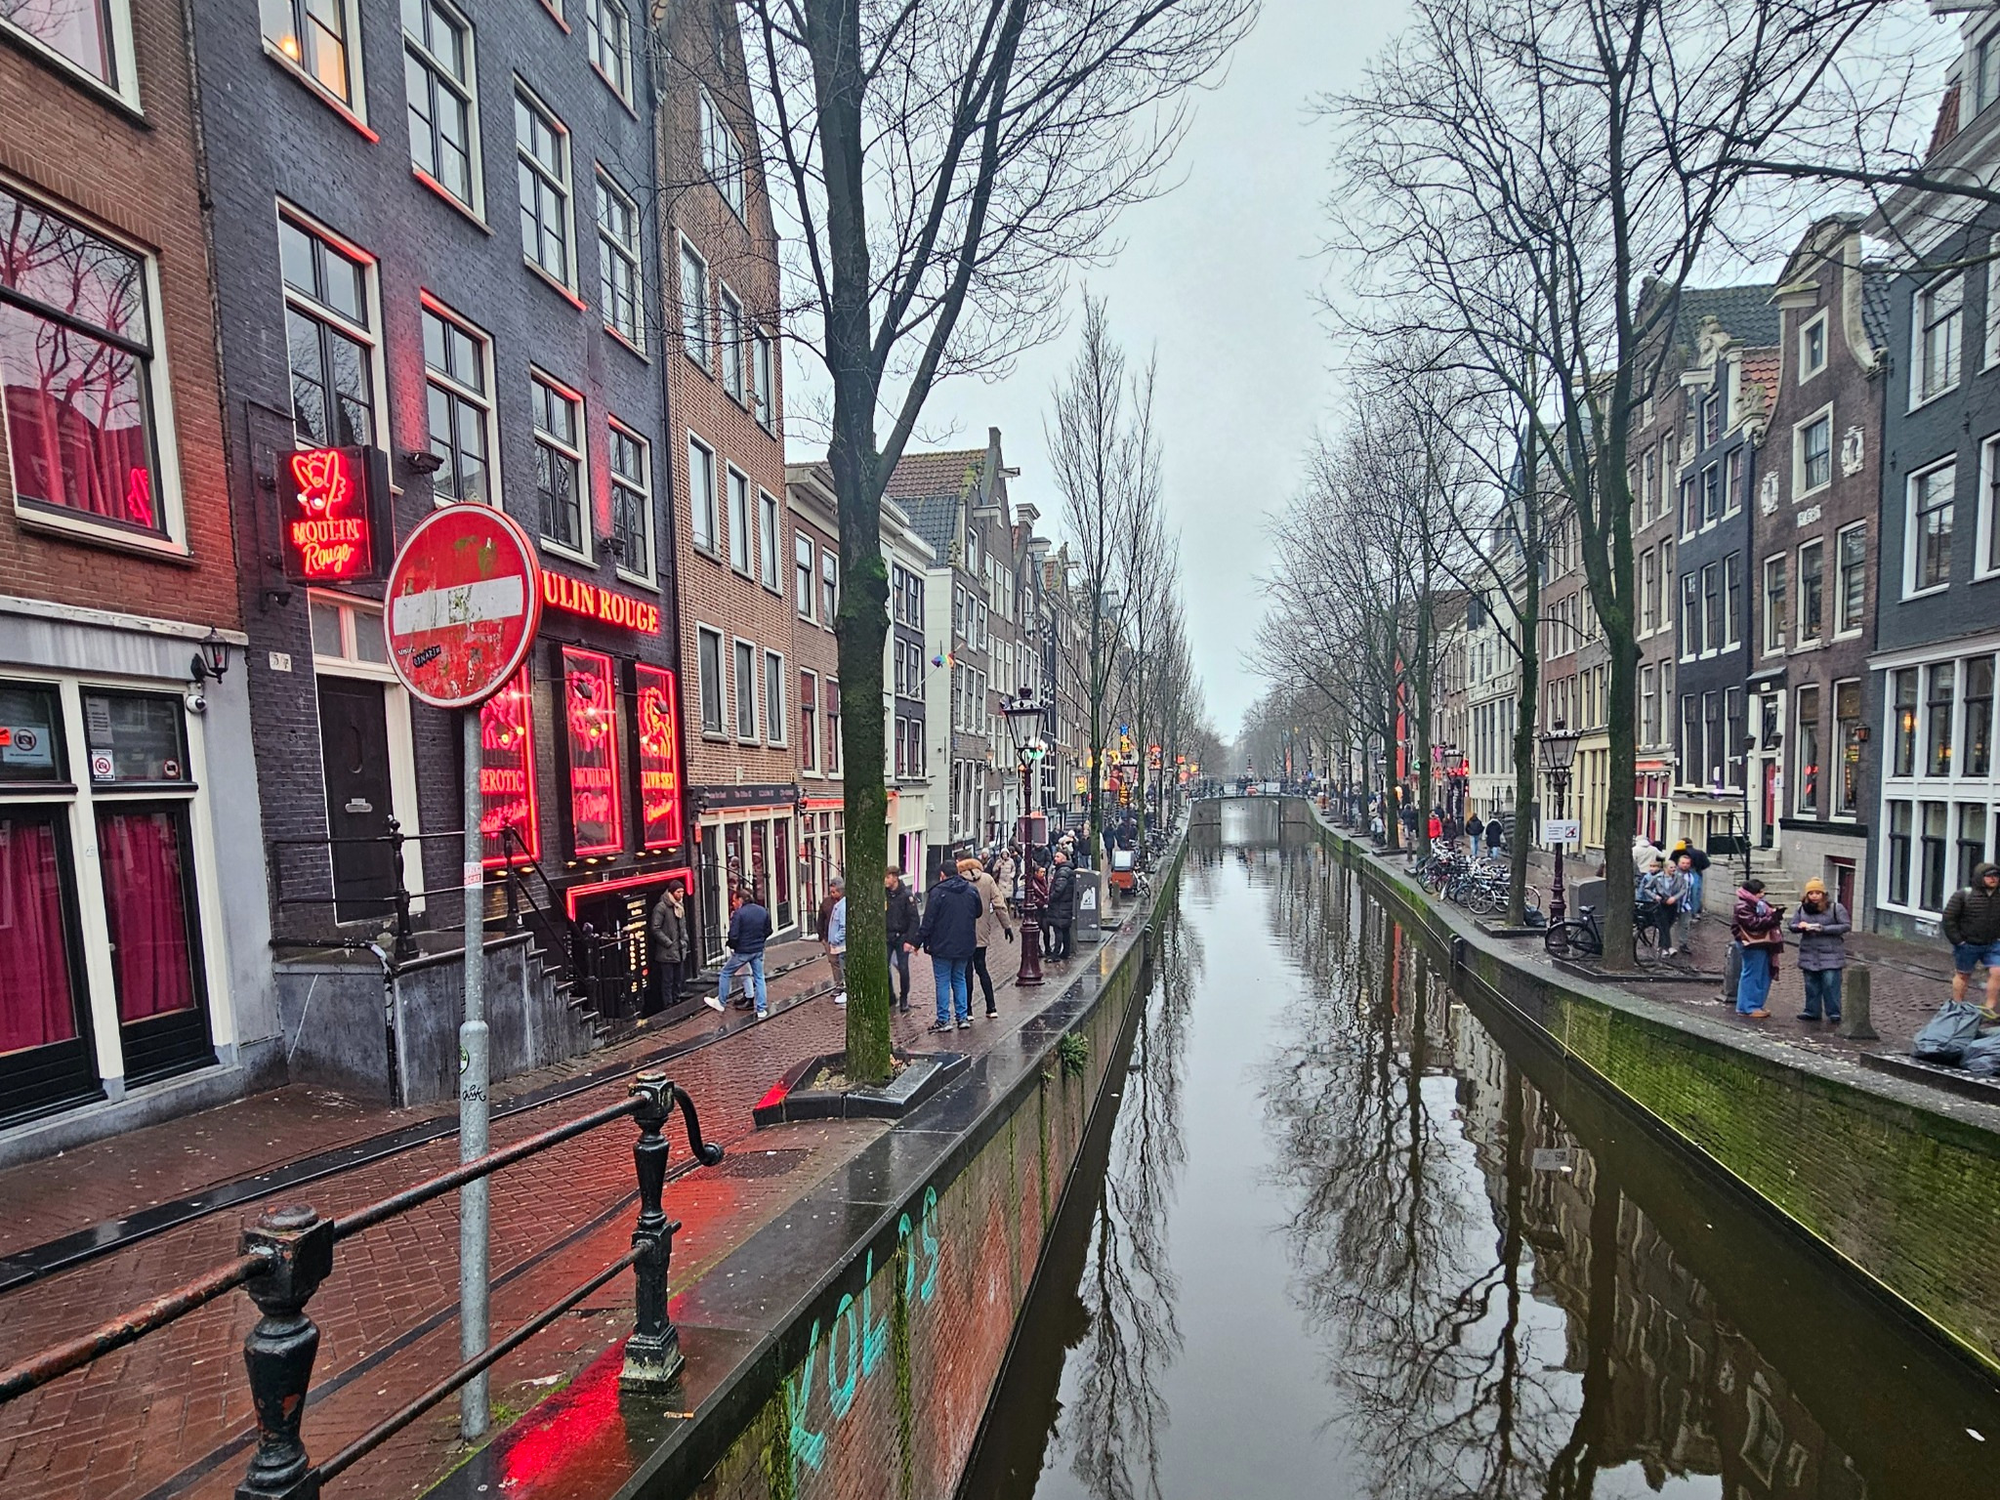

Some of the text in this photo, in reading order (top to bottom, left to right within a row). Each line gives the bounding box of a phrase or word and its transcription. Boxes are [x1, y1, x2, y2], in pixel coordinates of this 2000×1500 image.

[293, 519, 361, 544] MOULIN
[303, 543, 355, 574] Rouge
[541, 569, 659, 634] ULIN ROUGE
[480, 769, 525, 793] EROTIC
[573, 767, 611, 788] MOULIN
